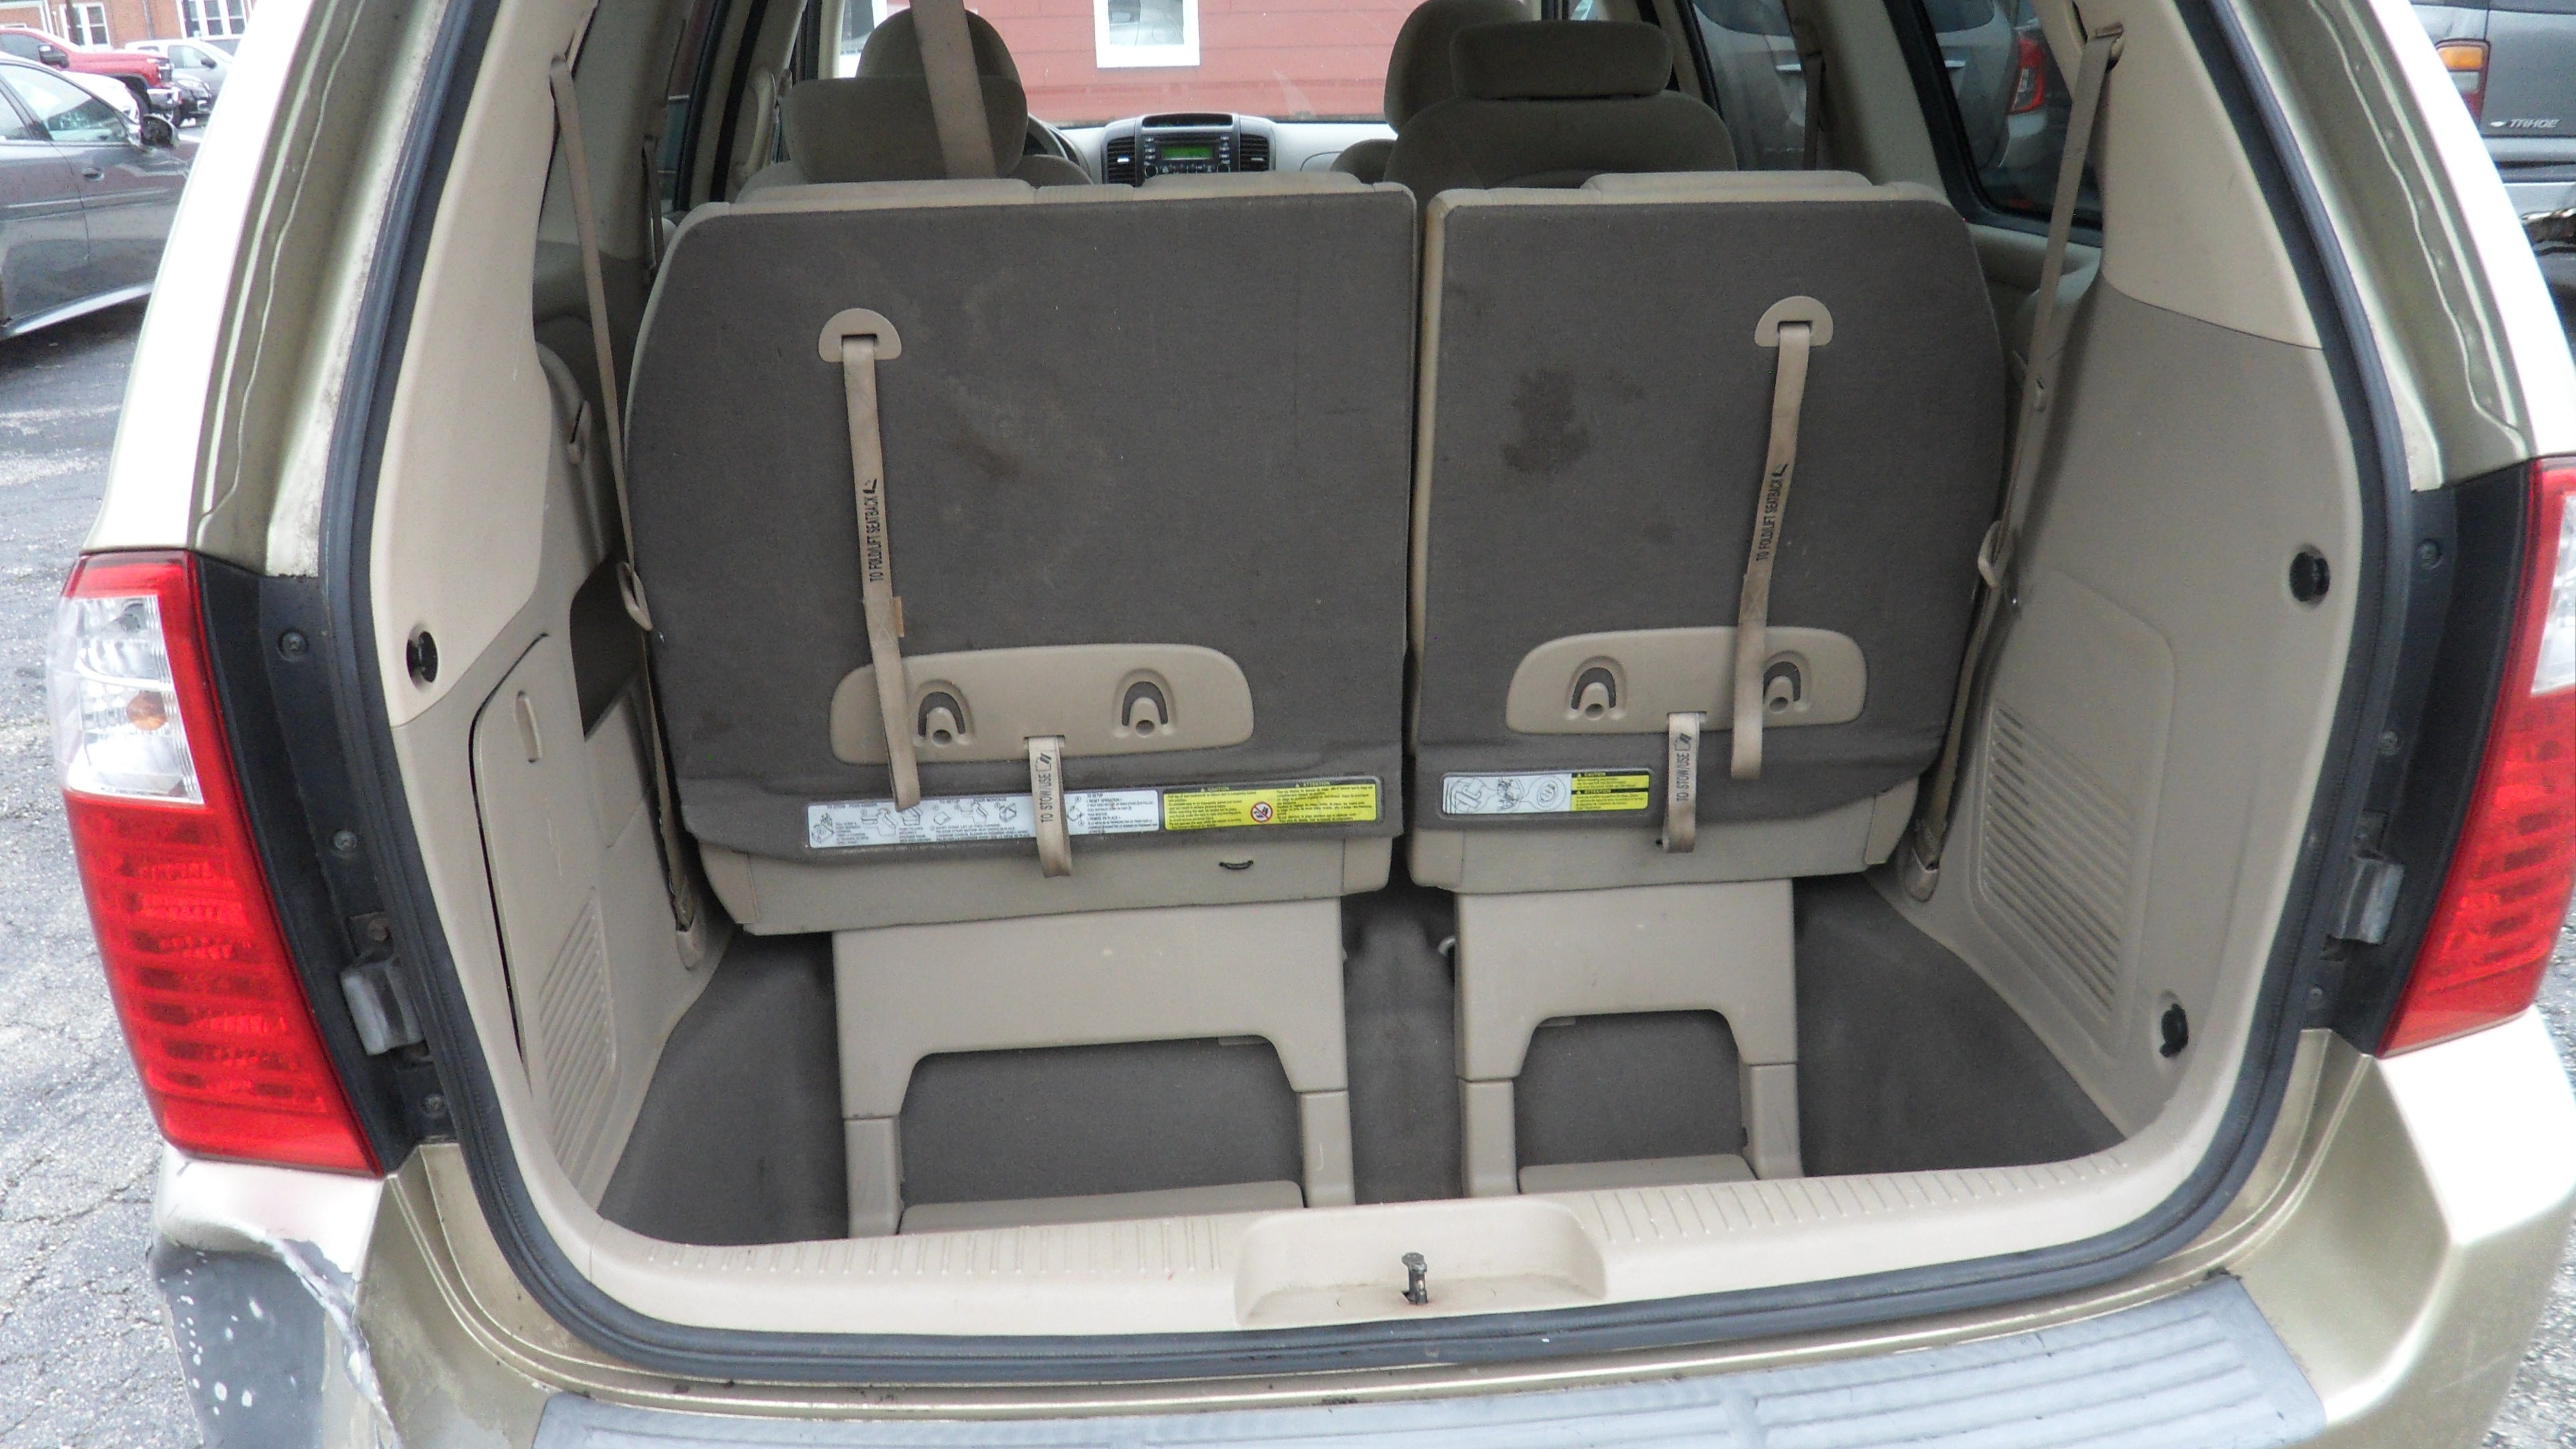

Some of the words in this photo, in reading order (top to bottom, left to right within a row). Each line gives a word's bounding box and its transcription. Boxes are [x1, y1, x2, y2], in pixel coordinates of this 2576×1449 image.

[2509, 119, 2561, 129] TAHOE
[863, 496, 881, 534] SEATBACK
[1756, 551, 1769, 561] TO
[869, 572, 884, 582] TO
[1676, 752, 1690, 790] STOW/USE
[1038, 772, 1053, 810] STOW/USE
[1676, 792, 1689, 802] TO
[1040, 812, 1053, 823] TO
